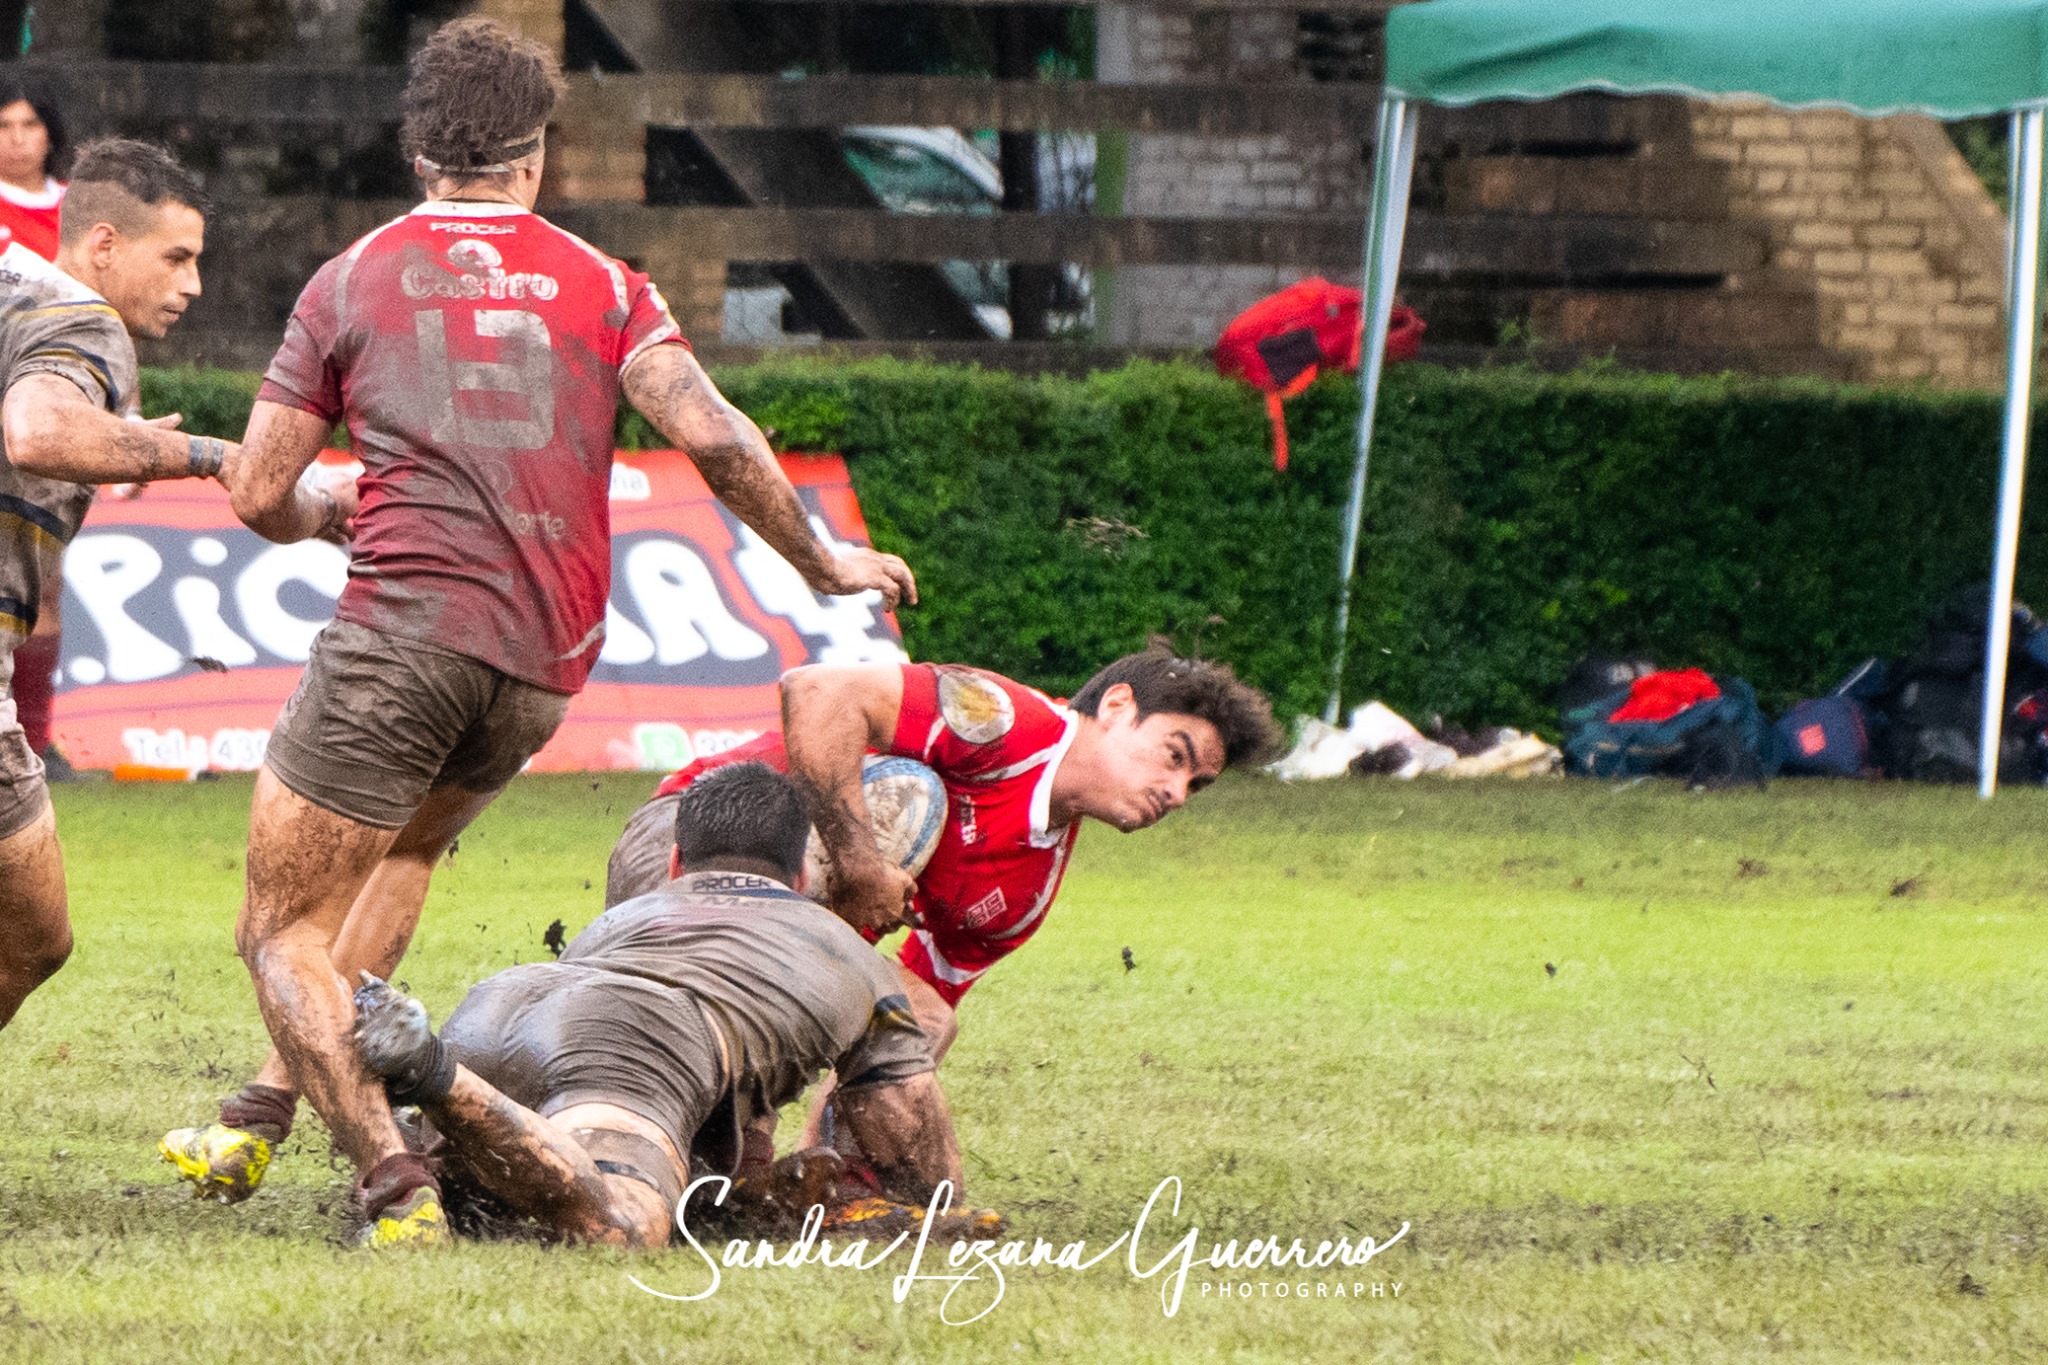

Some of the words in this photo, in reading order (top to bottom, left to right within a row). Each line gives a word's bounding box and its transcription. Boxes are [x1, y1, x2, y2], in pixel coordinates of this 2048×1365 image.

[430, 222, 517, 235] PROCER
[402, 266, 560, 301] Castro
[415, 309, 555, 450] 13
[692, 874, 773, 892] PROCER
